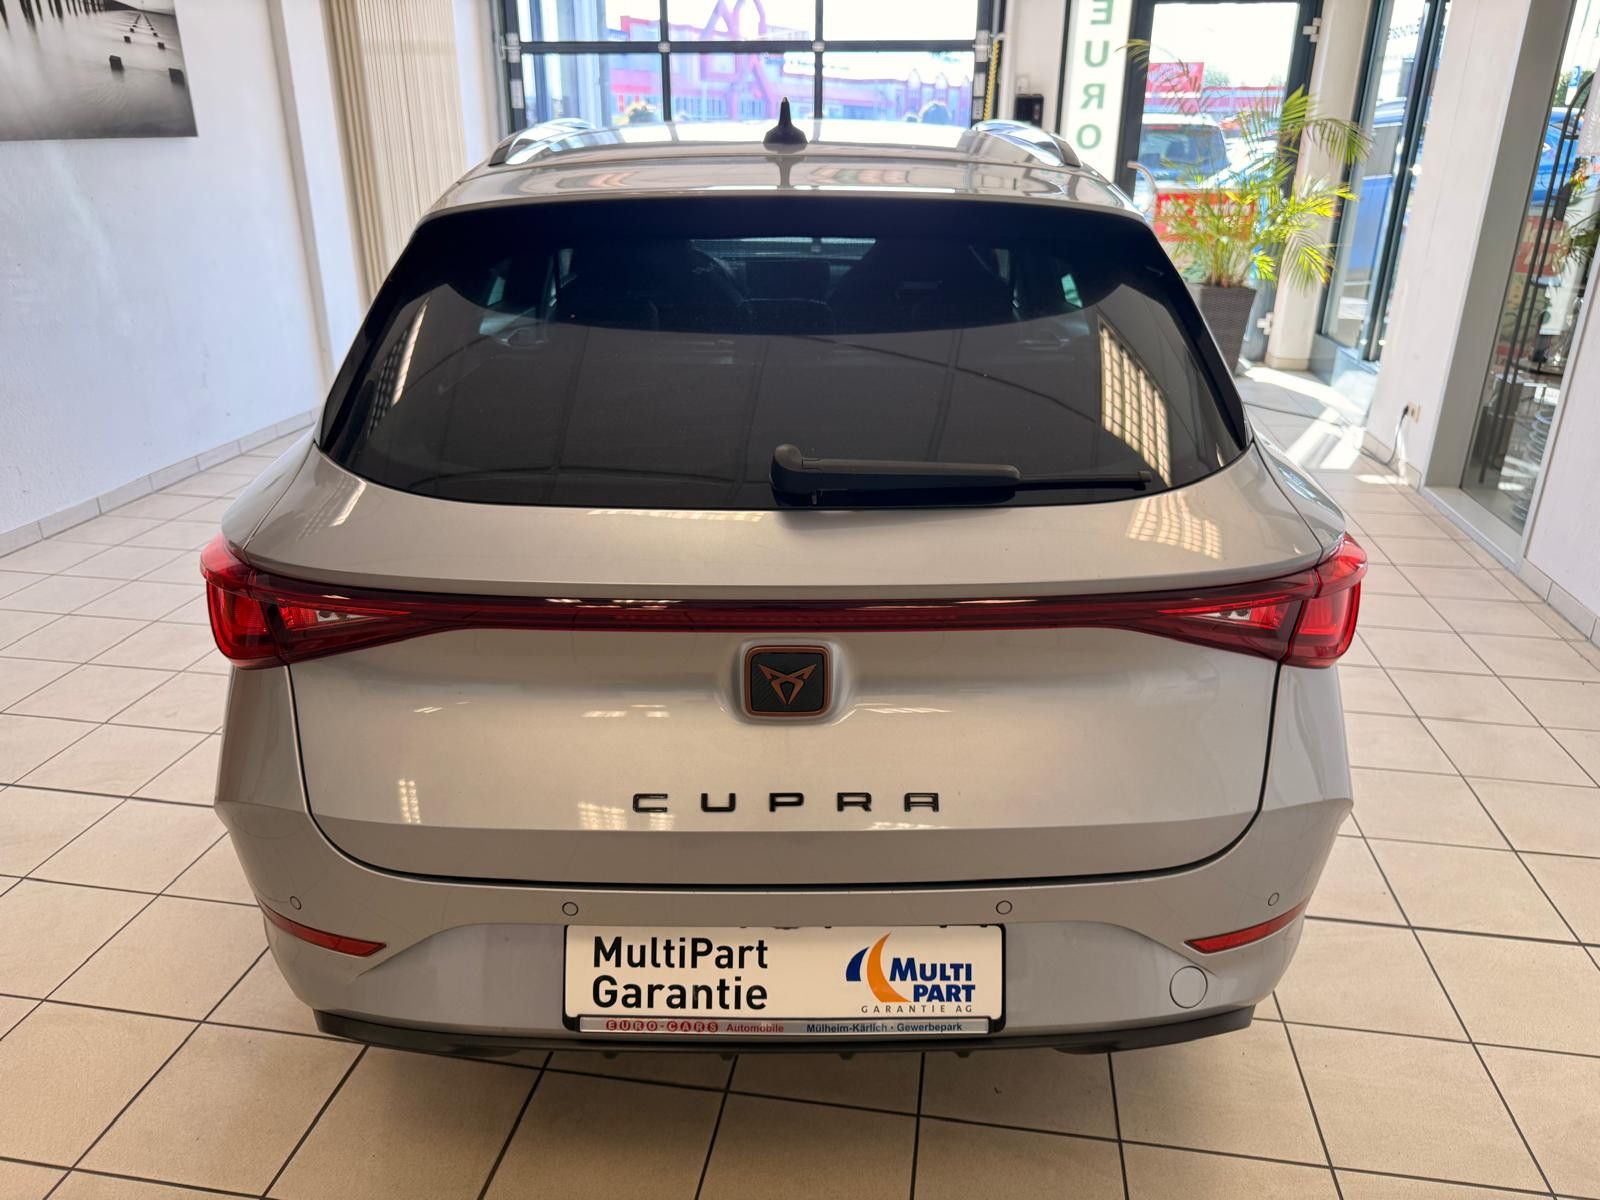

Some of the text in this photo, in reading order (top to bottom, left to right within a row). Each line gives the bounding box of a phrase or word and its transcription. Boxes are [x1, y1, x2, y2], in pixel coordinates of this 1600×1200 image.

[632, 792, 940, 813] CUPRA
[593, 936, 768, 969] MultiPart
[889, 957, 972, 982] MULTI
[592, 975, 768, 1010] Garantie
[913, 984, 976, 1003] PART
[860, 1004, 972, 1014] GARANTIE AG
[726, 1023, 785, 1034] Automobile
[806, 1022, 888, 1034] Mülheim-Kärlich
[896, 1022, 963, 1034] Gewerbepark
